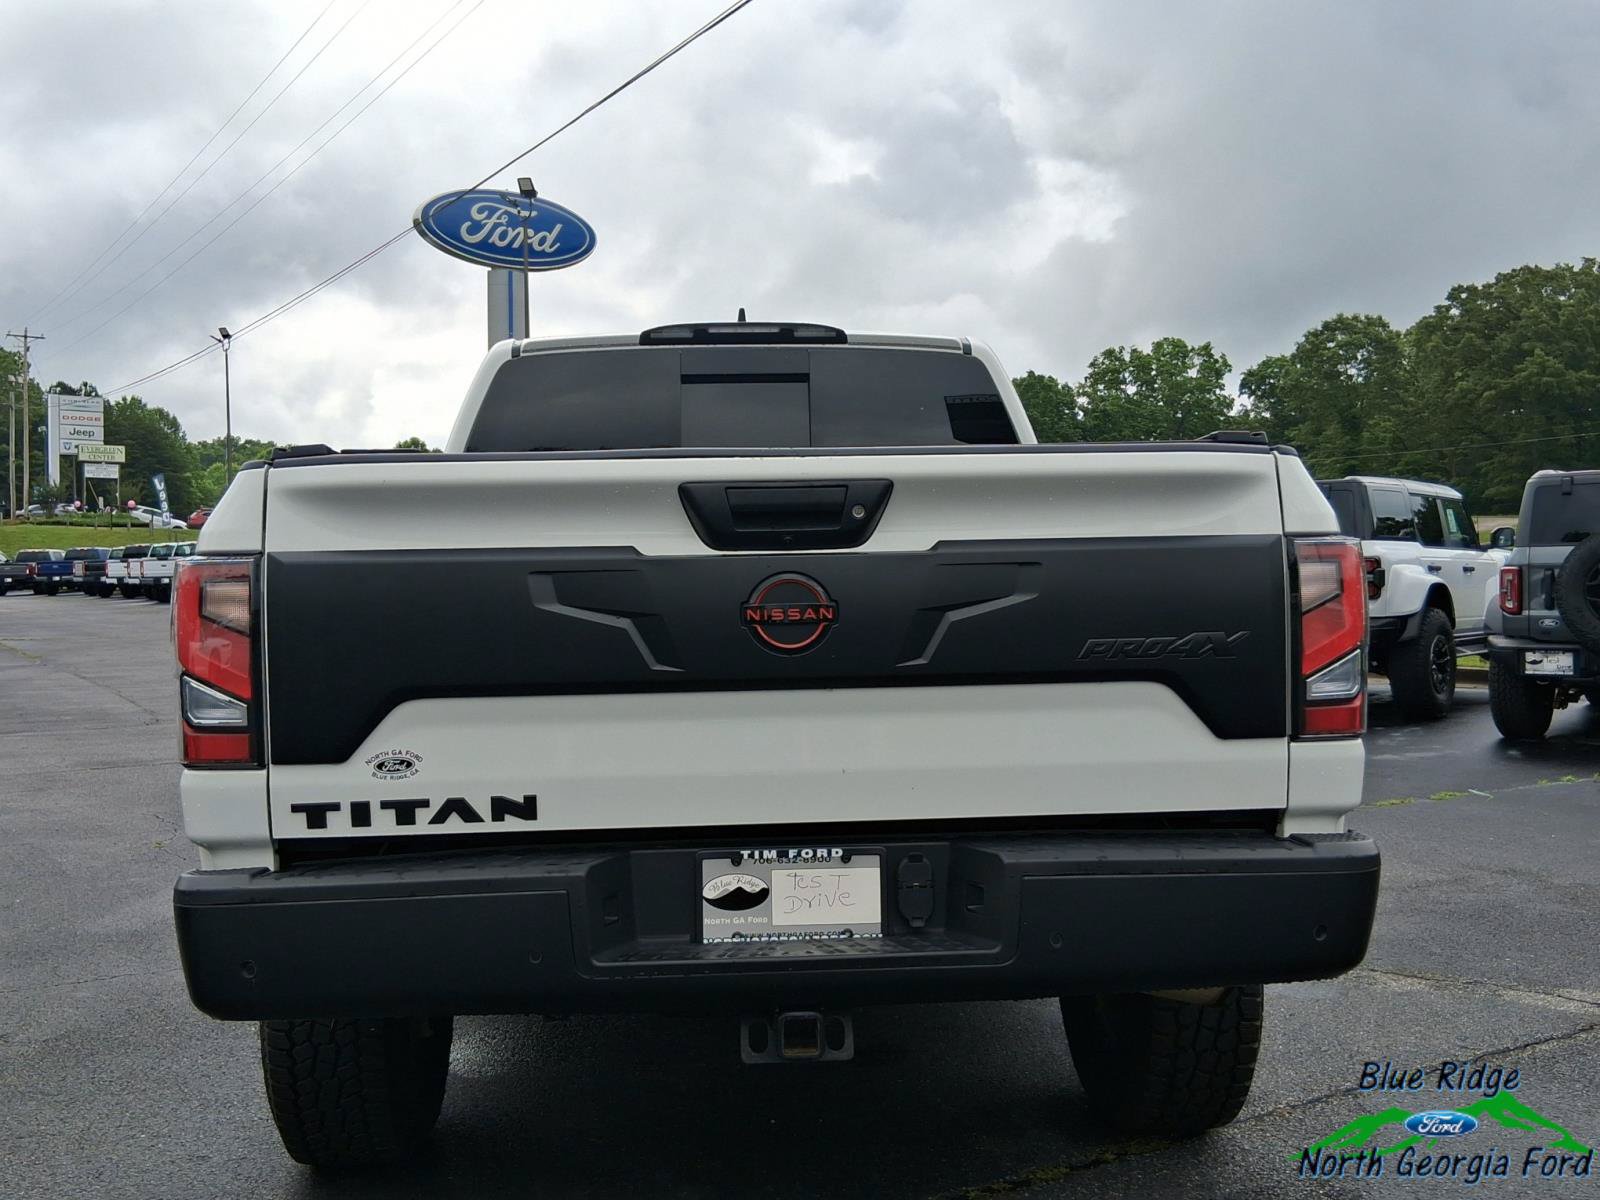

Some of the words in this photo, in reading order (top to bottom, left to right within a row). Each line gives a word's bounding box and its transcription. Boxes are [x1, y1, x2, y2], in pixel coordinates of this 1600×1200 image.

[460, 202, 563, 253] Ford
[69, 427, 95, 438] Jeep
[81, 445, 124, 454] EVERGREEN
[746, 607, 834, 621] NISSAN
[365, 750, 390, 766] NORTH
[405, 750, 424, 763] FORD
[382, 760, 407, 771] Ford
[291, 794, 538, 830] TITAN
[740, 850, 777, 860] TIM
[788, 848, 843, 858] FORD
